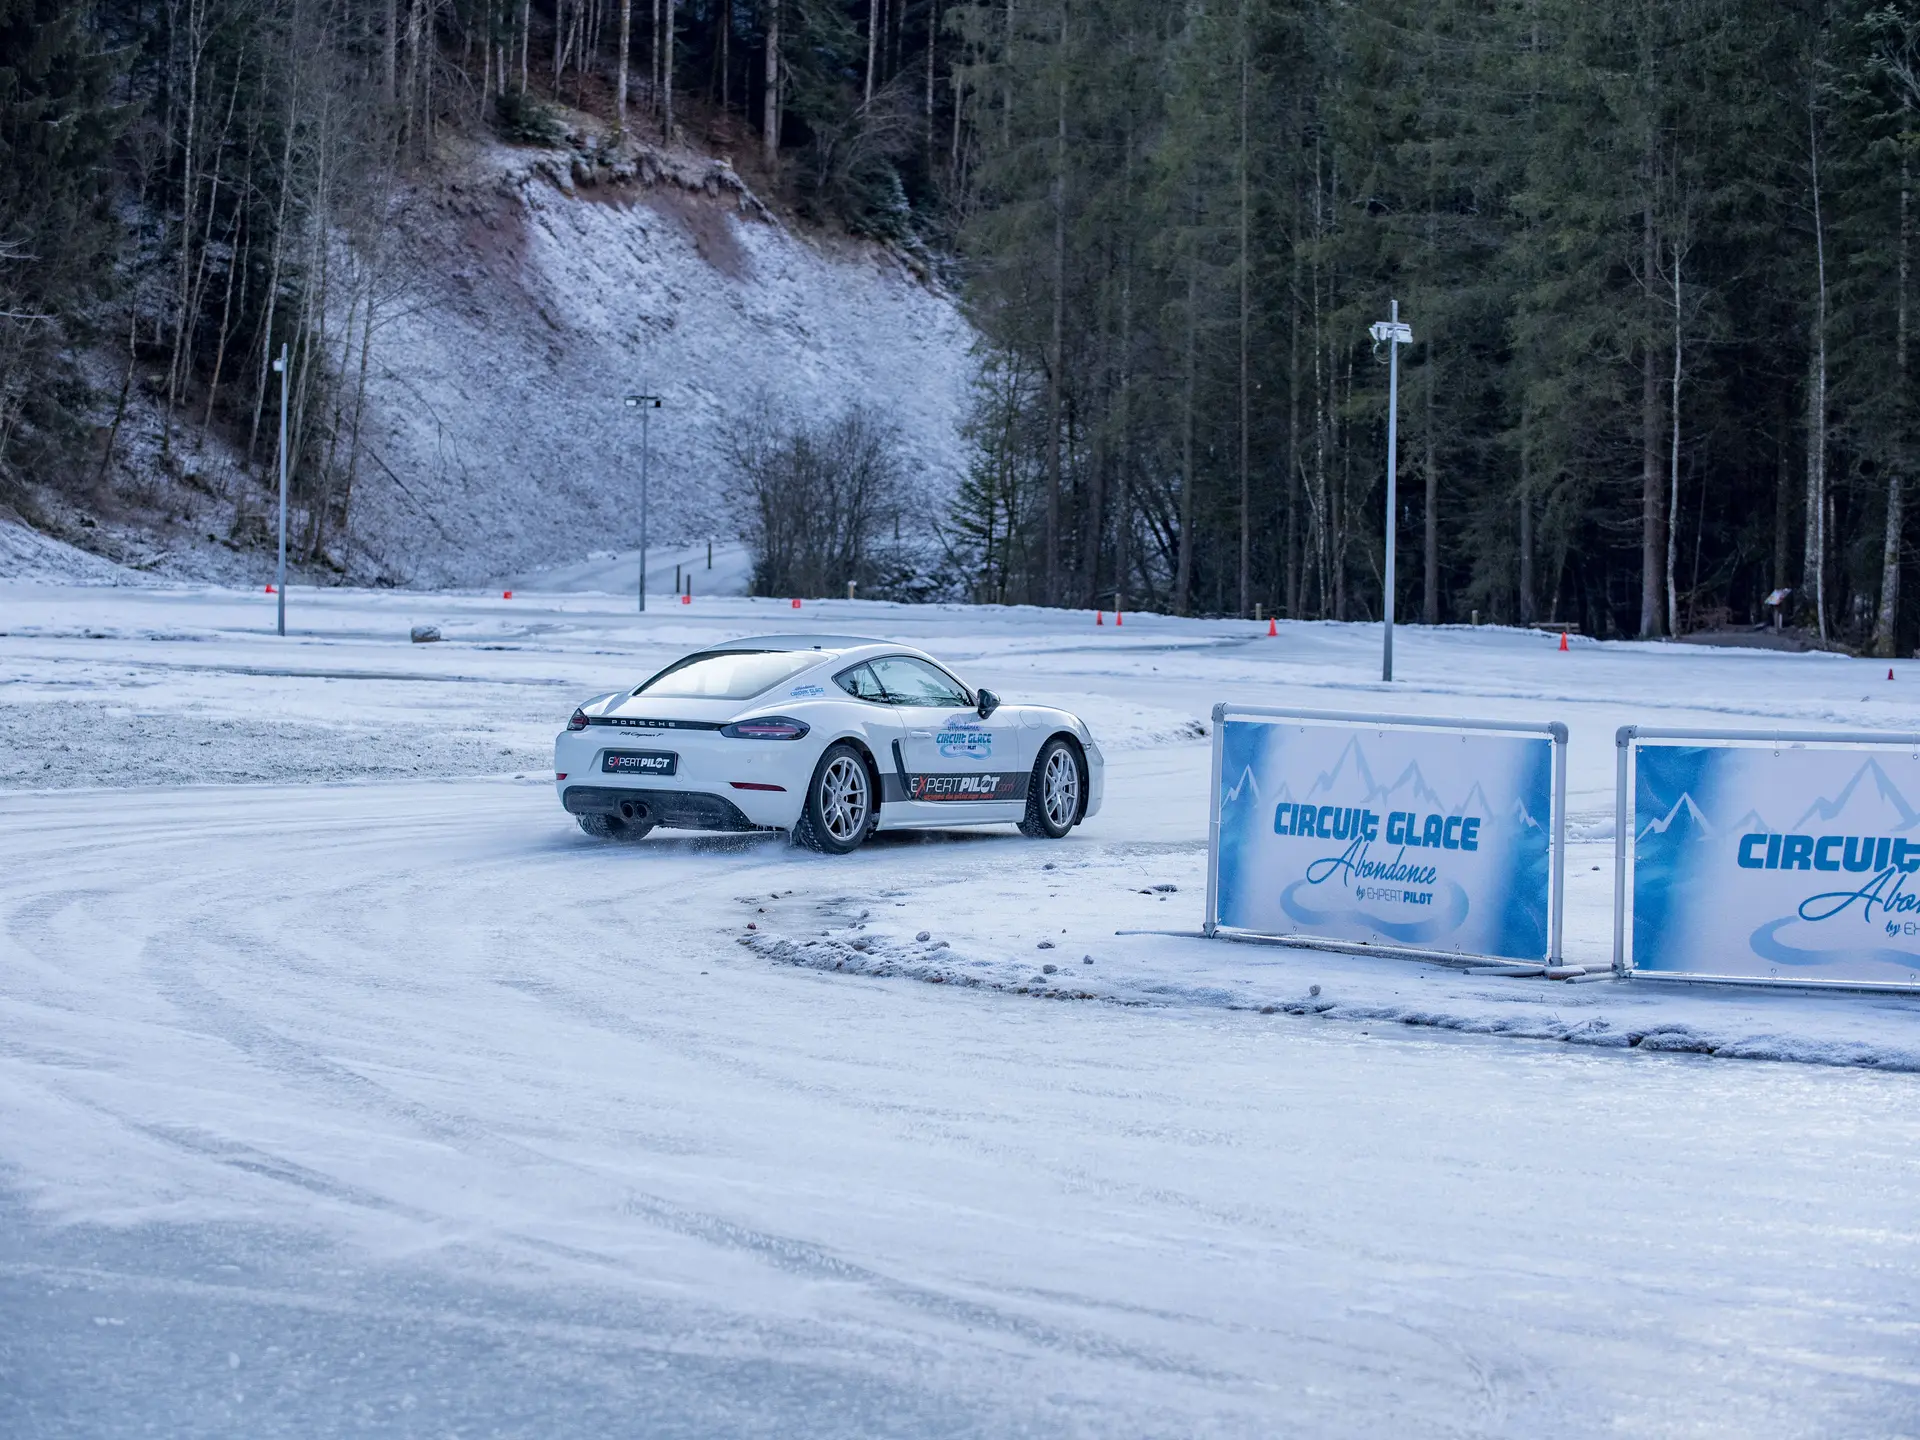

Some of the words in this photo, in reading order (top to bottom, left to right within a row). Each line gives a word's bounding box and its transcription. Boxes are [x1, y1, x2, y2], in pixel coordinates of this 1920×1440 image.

[611, 719, 676, 728] PORSCHE
[967, 733, 992, 744] GLACE
[1385, 811, 1481, 851] GLACE
[1306, 835, 1437, 888] Abondance
[1356, 885, 1366, 900] by
[1403, 891, 1433, 905] PILOT
[1798, 866, 1920, 924] Abo
[1885, 920, 1901, 937] by
